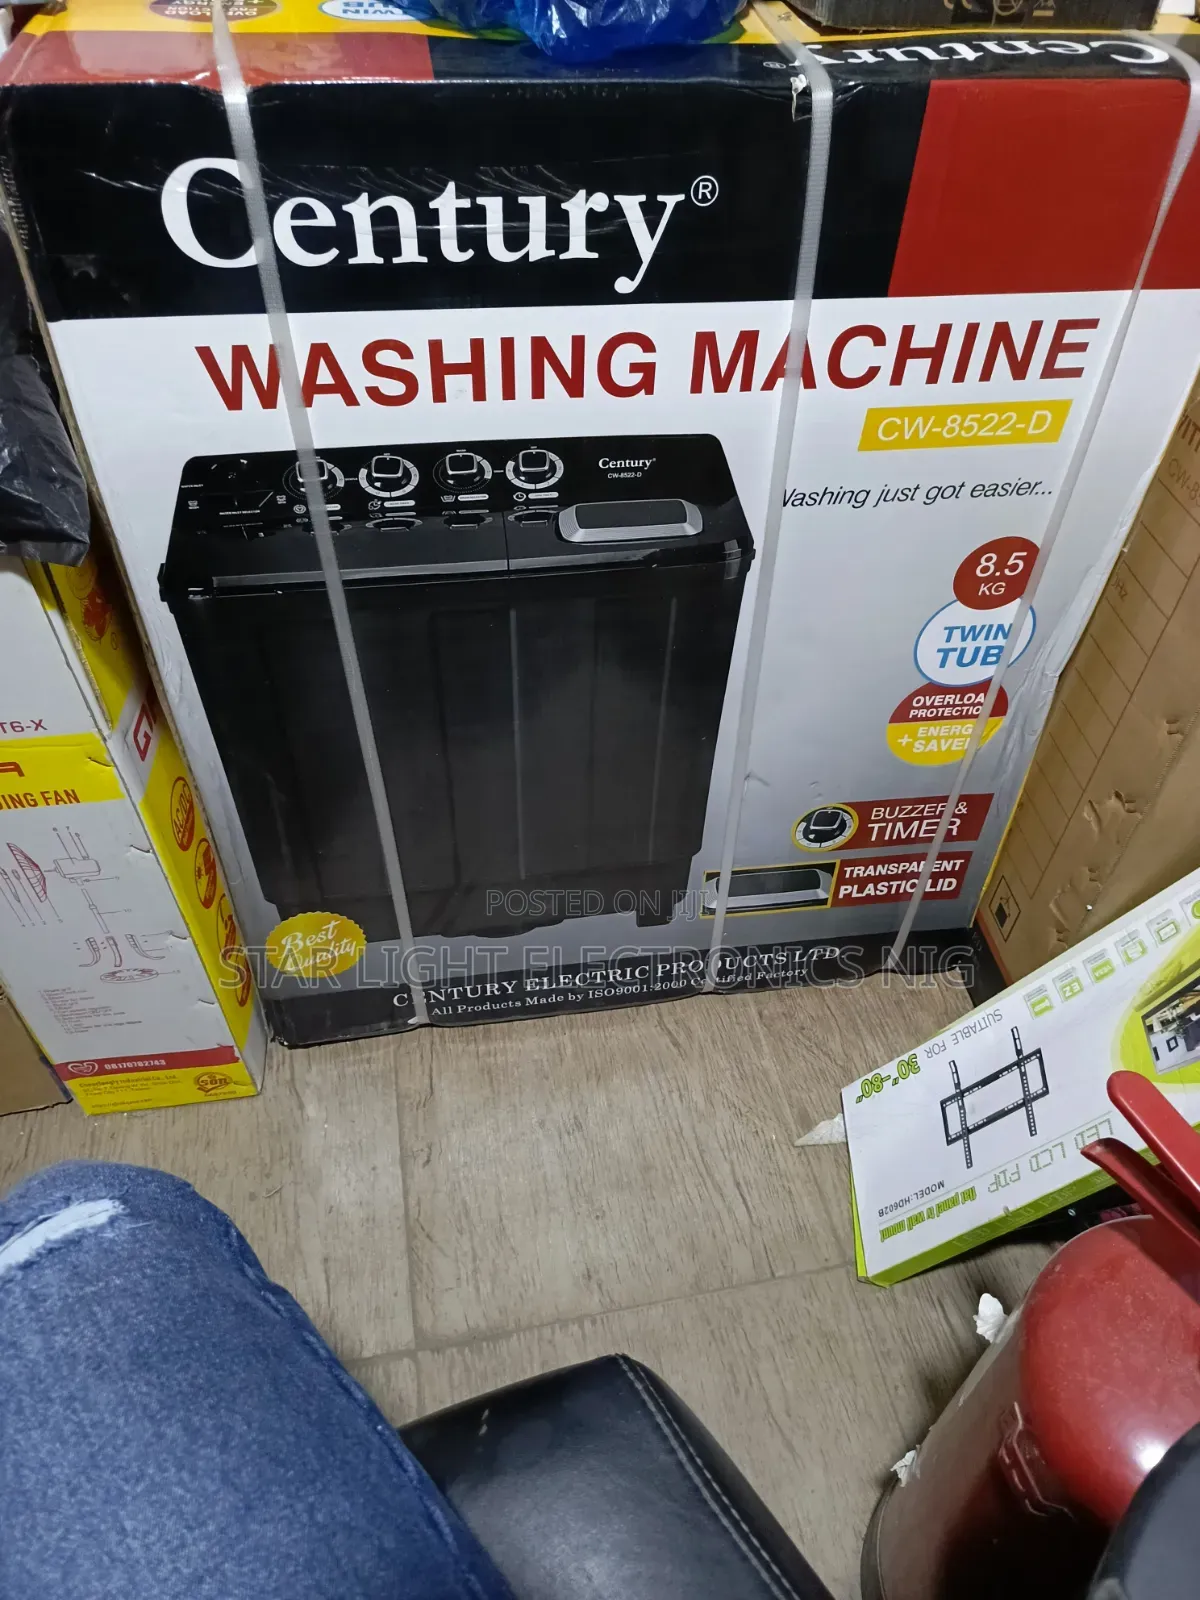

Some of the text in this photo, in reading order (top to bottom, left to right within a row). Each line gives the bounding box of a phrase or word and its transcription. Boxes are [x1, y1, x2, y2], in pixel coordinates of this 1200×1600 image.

[195, 318, 1100, 411] WASHING MACHINE
[877, 409, 1052, 442] CW-8522-D
[873, 484, 920, 508] just
[923, 481, 965, 505] got
[970, 477, 1052, 498] easier...
[975, 551, 1028, 578] 8.5
[978, 582, 1006, 596] KG
[943, 622, 1014, 643] TWIN
[936, 644, 1006, 669] TUB
[909, 705, 983, 719] PROTECTIO
[912, 692, 986, 707] OVERLOA
[917, 723, 974, 737] ENERG
[912, 737, 970, 753] SAVE
[0, 788, 81, 811] ING FAN
[871, 802, 947, 820] BUZZER
[867, 818, 961, 842] TIMER
[838, 878, 958, 899] PLASTIC LID
[281, 919, 341, 954] Best
[525, 964, 650, 992] ELECTRIC
[655, 951, 787, 977] PROUCTS
[793, 946, 845, 963] LTD.
[431, 967, 809, 1016] All Products Made by ISO9001:2000 Cetified Factory
[924, 1008, 1003, 1059] SUITABLE FOR
[1028, 1141, 1067, 1173] LCD
[988, 1162, 1021, 1194] PDP
